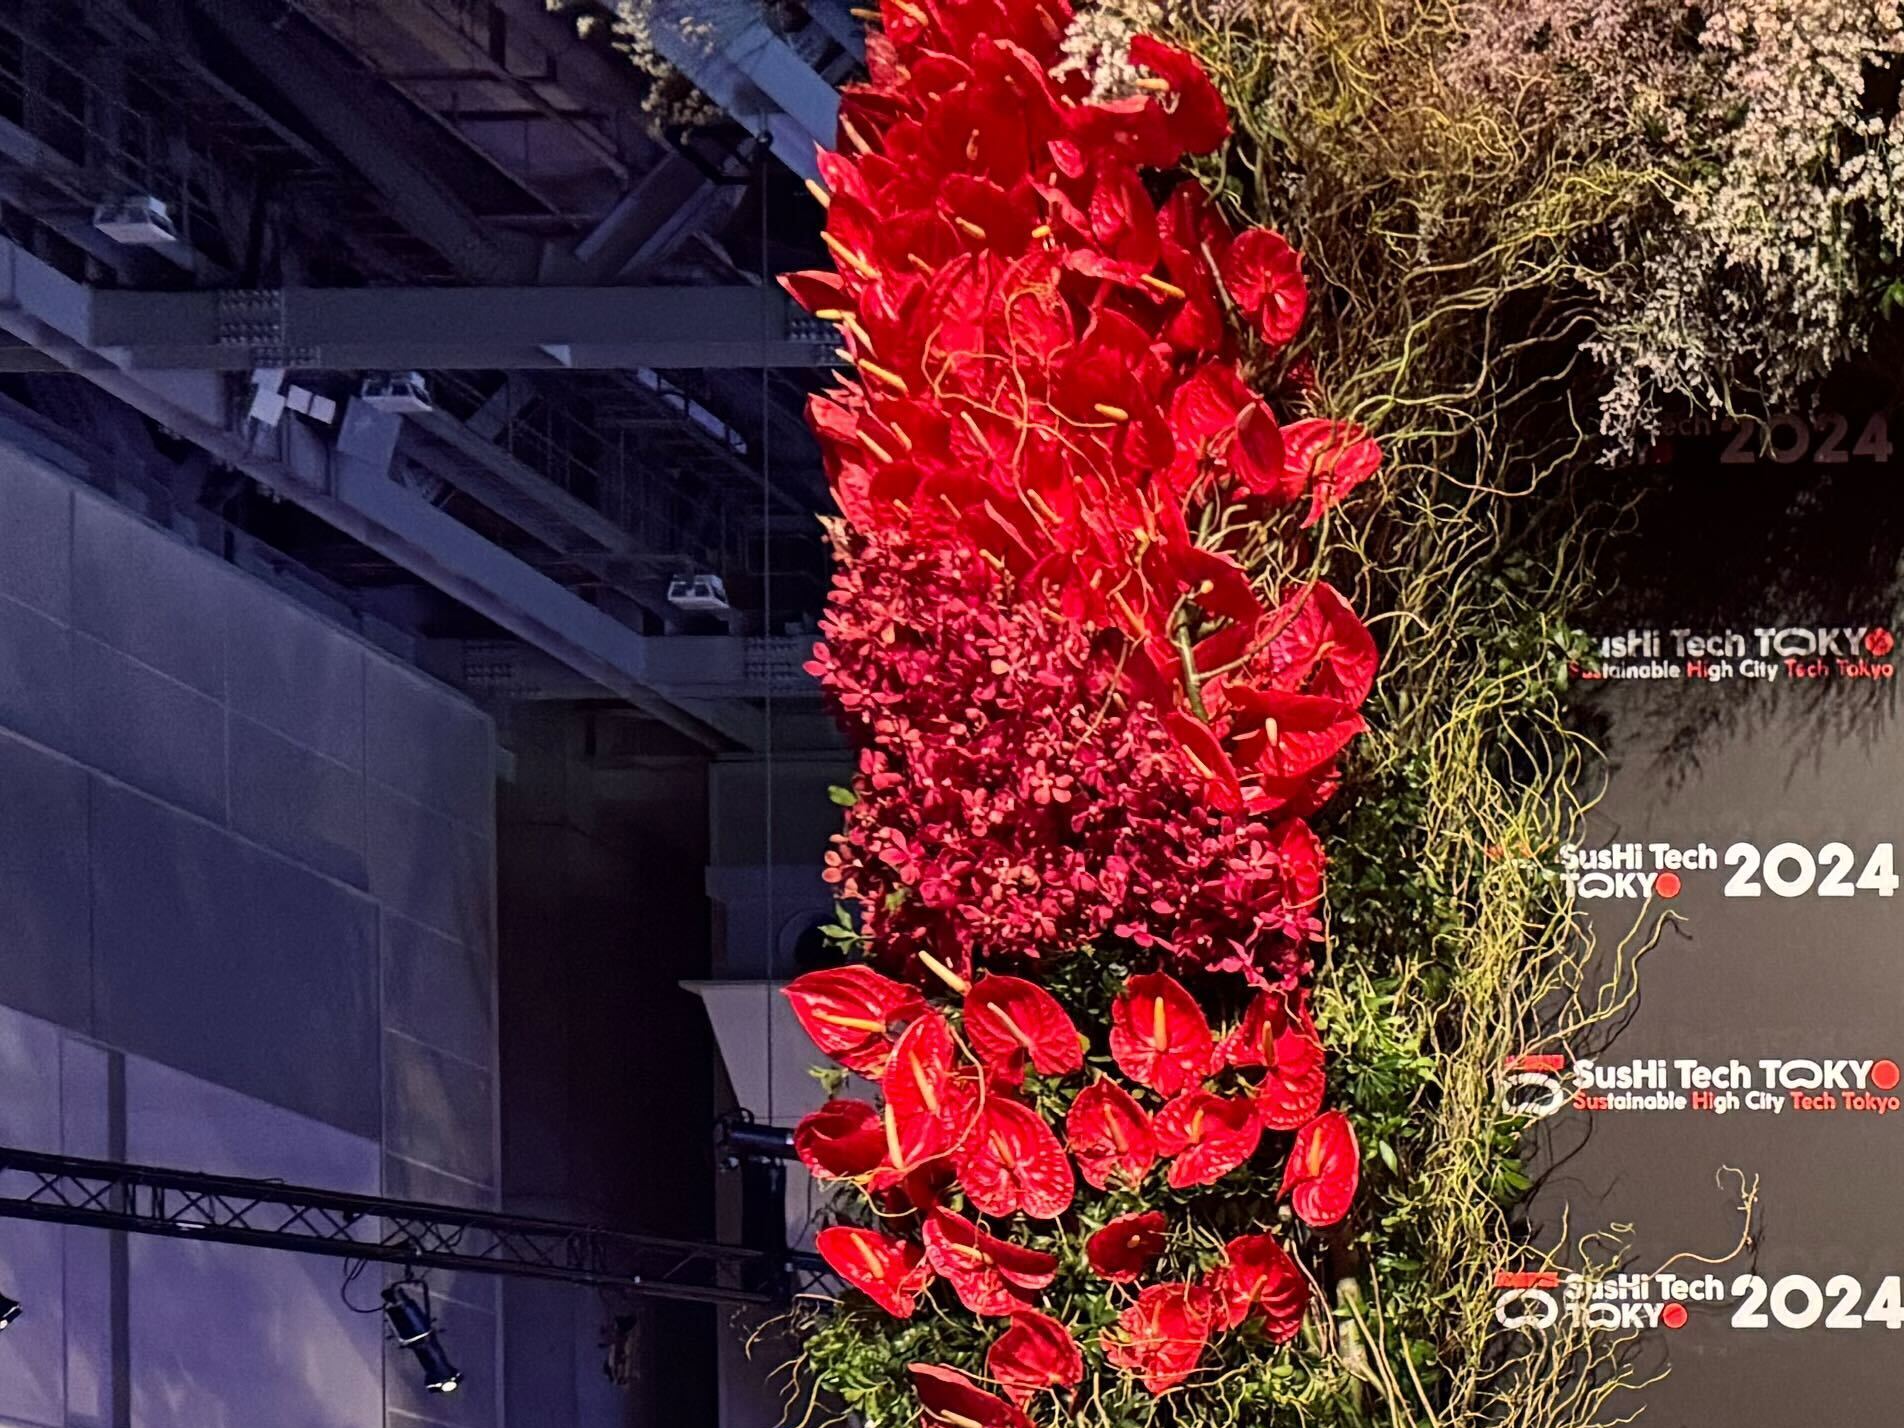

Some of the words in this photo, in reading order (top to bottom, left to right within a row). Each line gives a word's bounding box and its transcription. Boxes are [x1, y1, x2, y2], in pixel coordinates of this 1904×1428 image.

[1573, 1060, 1667, 1089] SusHi
[1674, 1061, 1751, 1089] Tech
[1759, 1060, 1899, 1089] TOKYO
[1573, 1091, 1686, 1110] Sustainable
[1693, 1091, 1740, 1114] High
[1746, 1091, 1785, 1113] City
[1790, 1092, 1836, 1109] Tech
[1842, 1092, 1900, 1114] Tokyo
